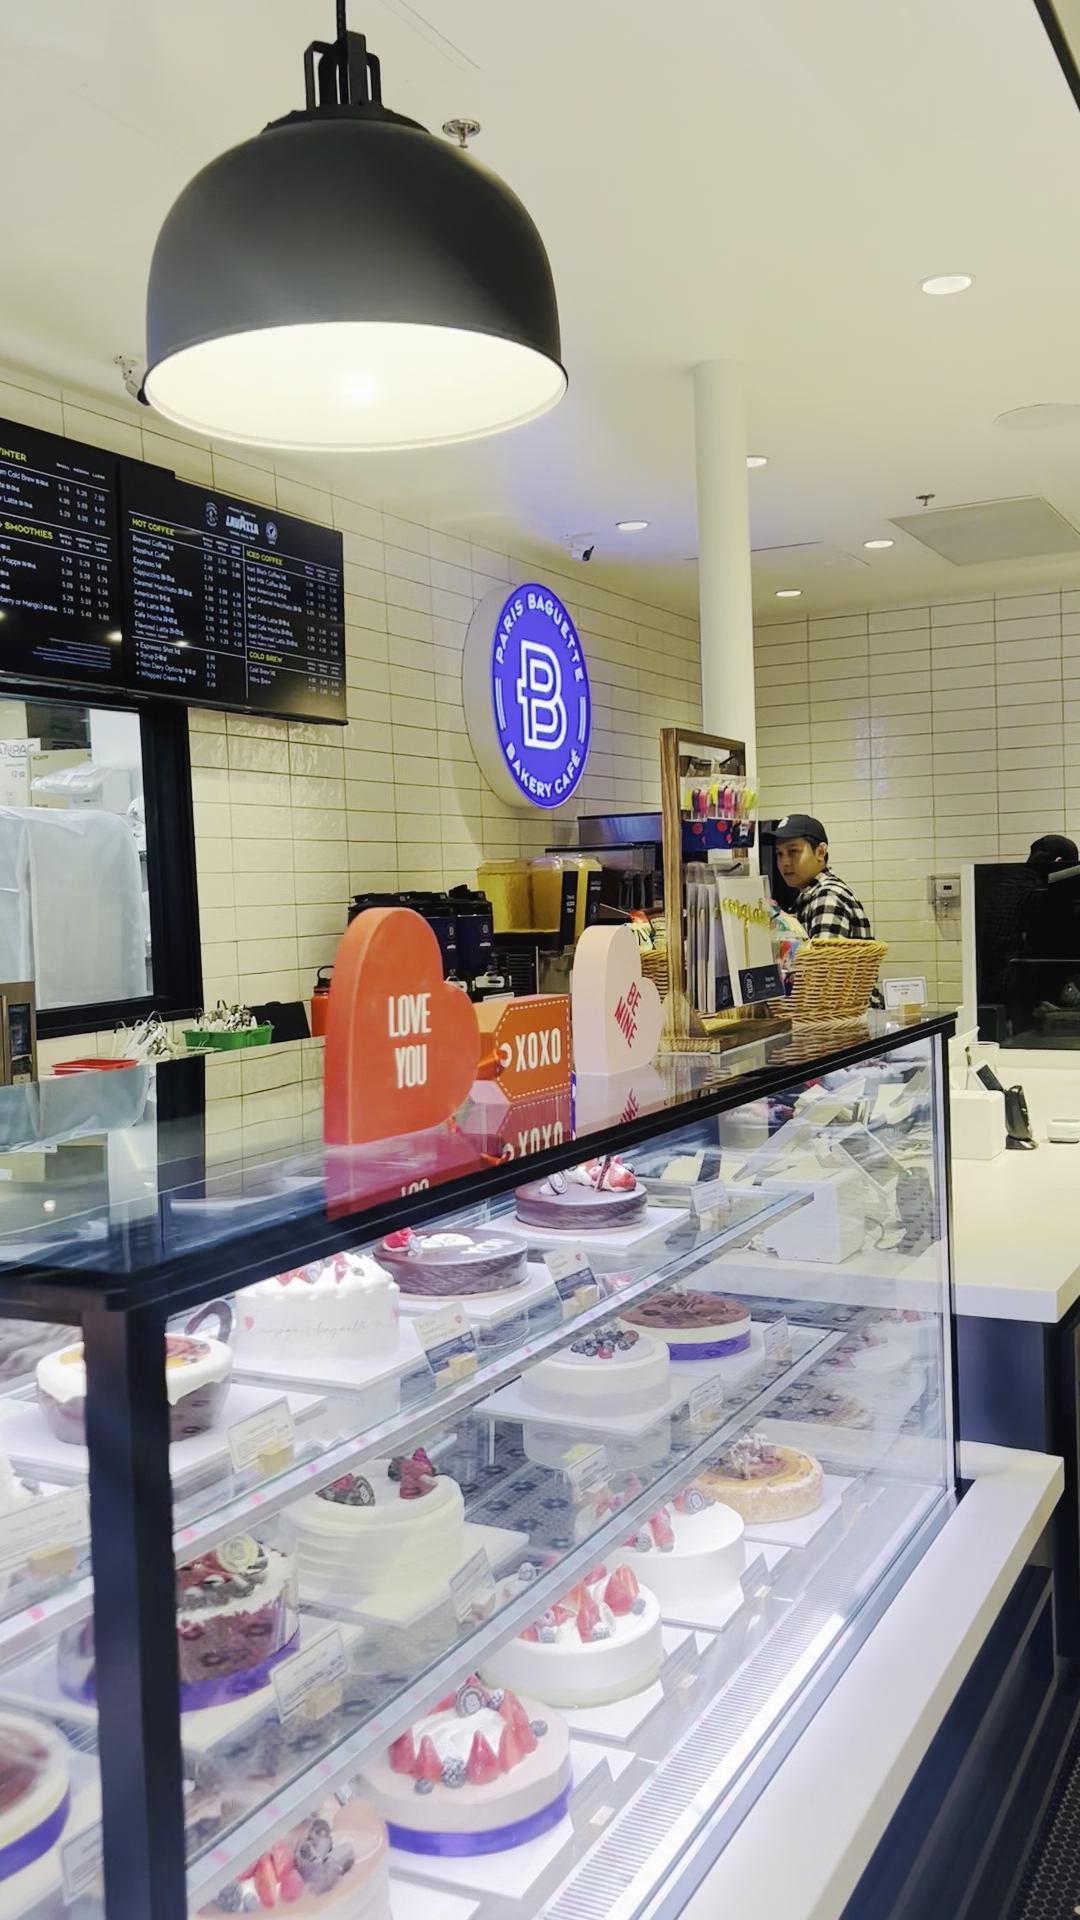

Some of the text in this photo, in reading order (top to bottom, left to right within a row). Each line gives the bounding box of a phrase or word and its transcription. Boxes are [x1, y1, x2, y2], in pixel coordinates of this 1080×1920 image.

[4, 521, 53, 540] SMOOTHIES
[132, 518, 175, 536] HOT COFFEE
[495, 592, 584, 683] PARIS BAGUETTE
[505, 741, 552, 798] BAKERY
[388, 993, 432, 1038] LOVE
[613, 995, 639, 1049] MINE
[624, 981, 643, 1018] BE
[394, 1043, 428, 1089] YOU
[514, 1027, 562, 1073] XOXO
